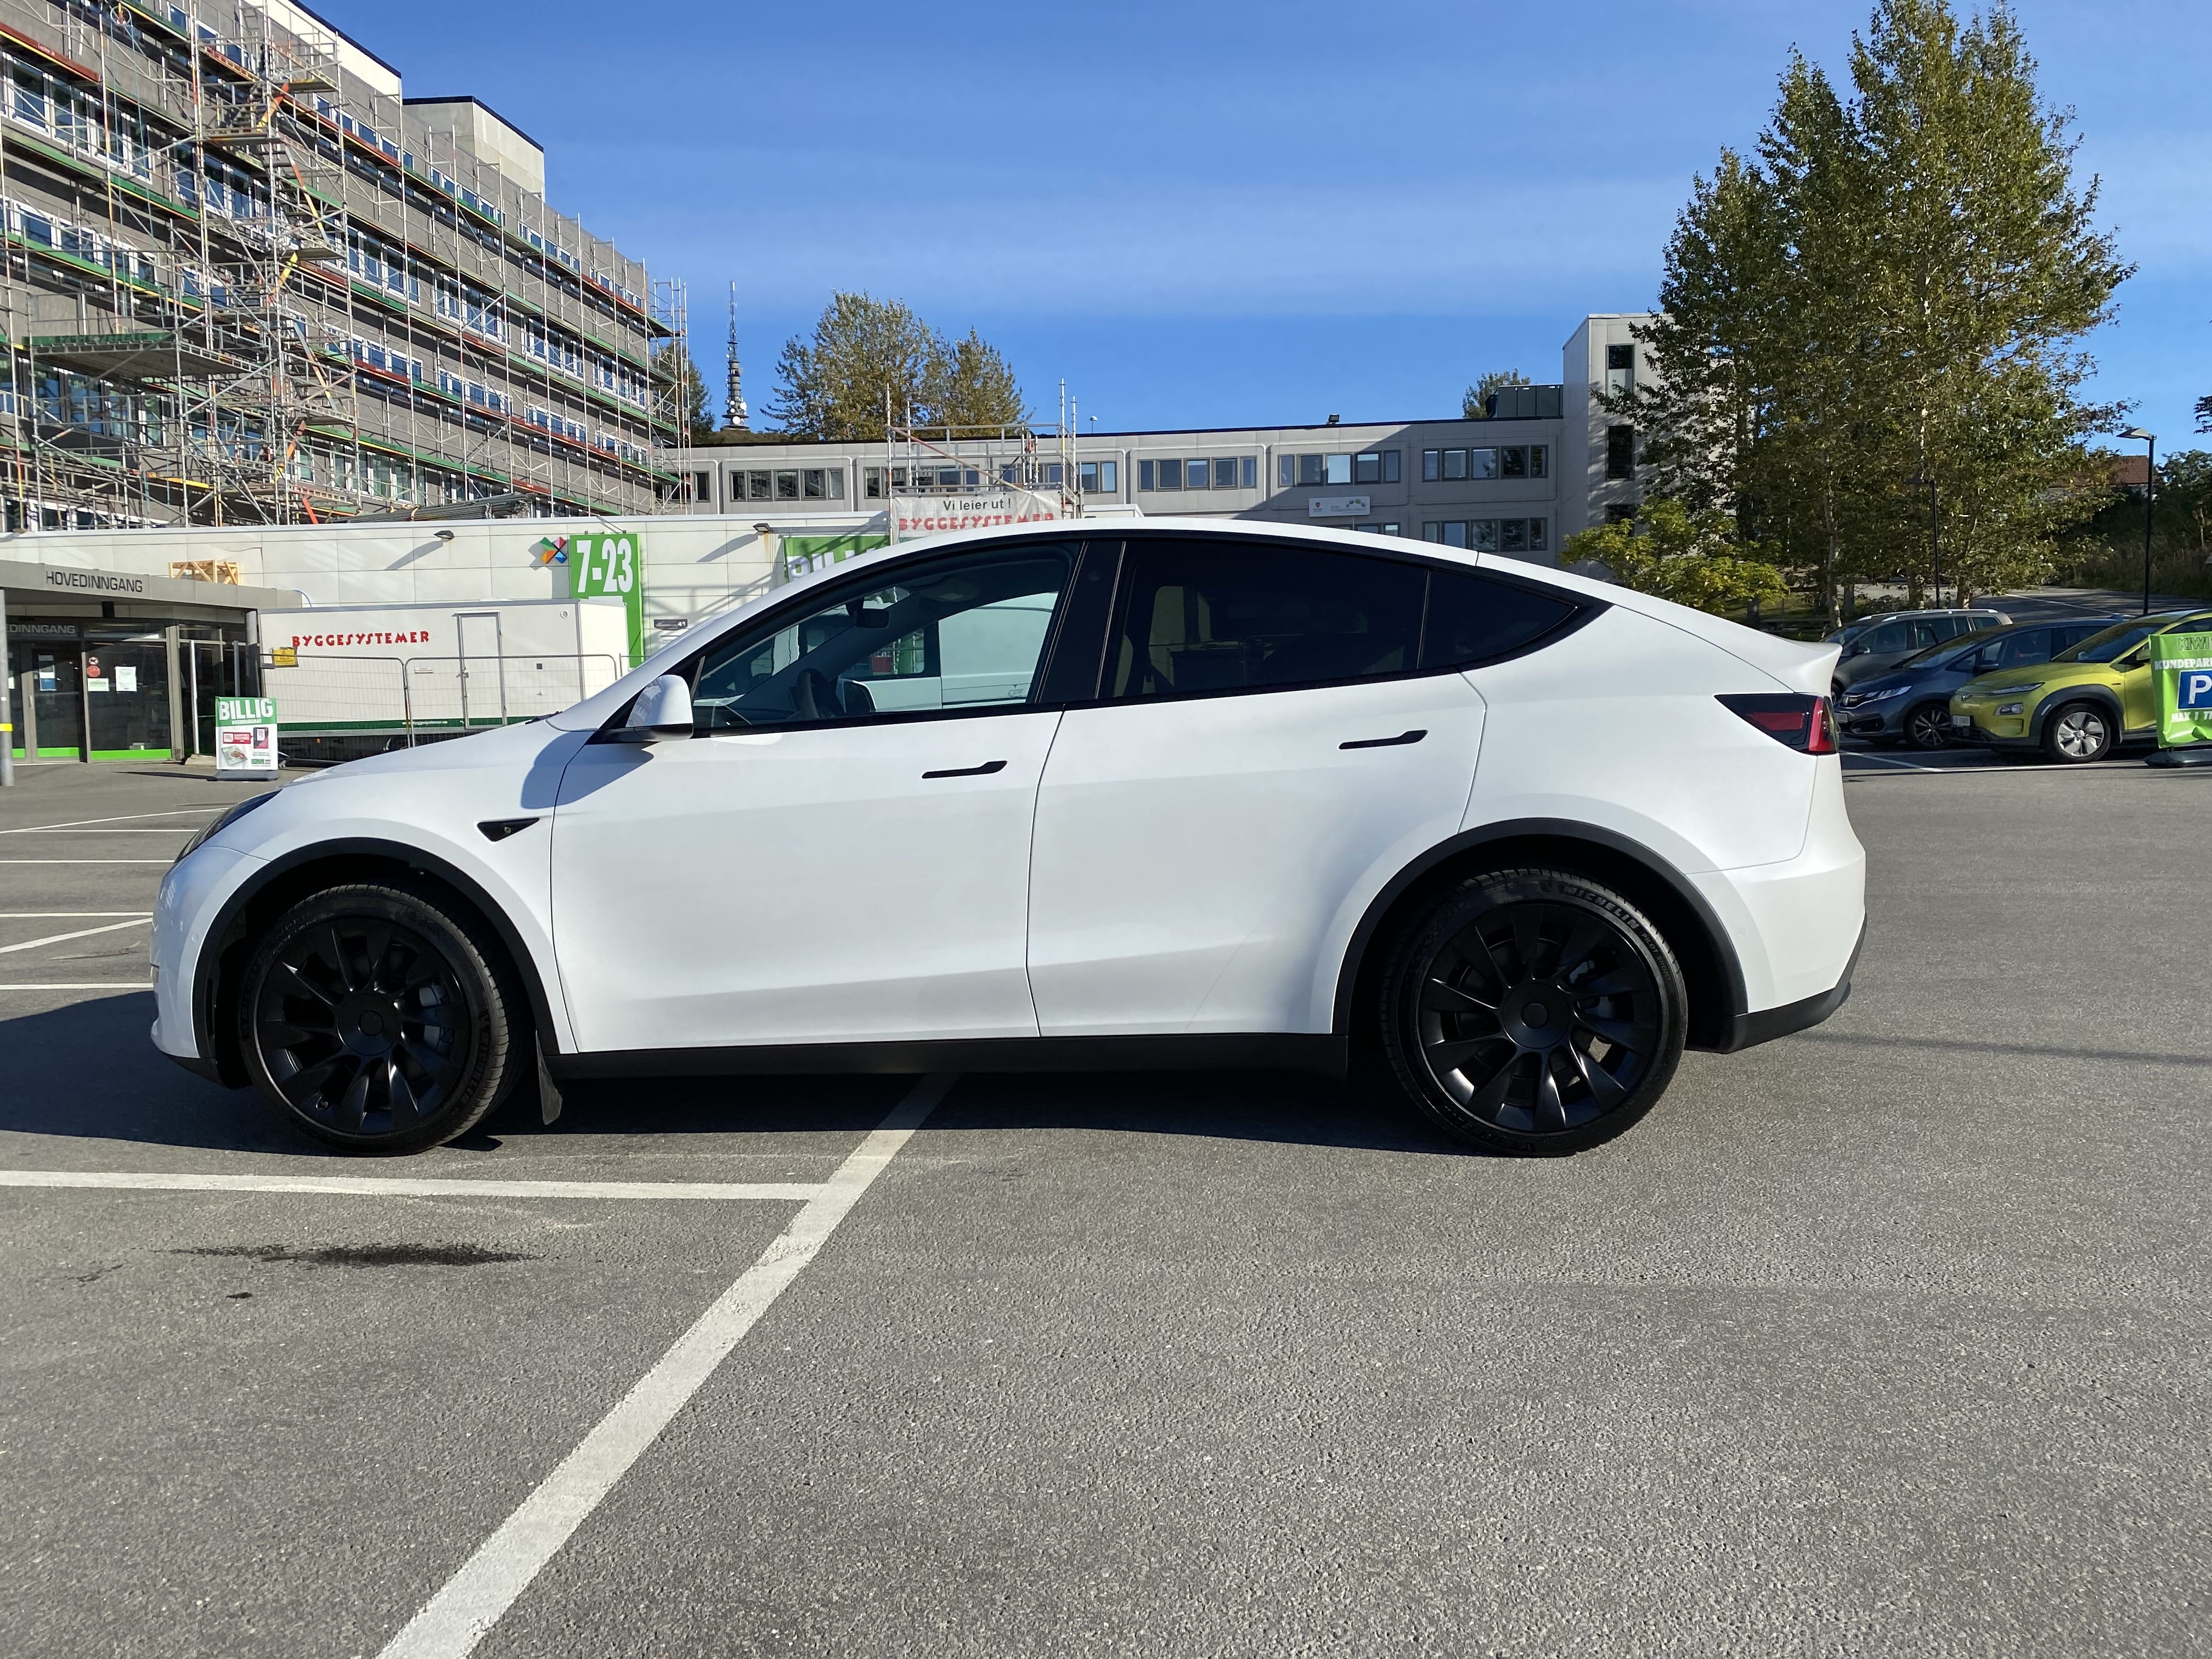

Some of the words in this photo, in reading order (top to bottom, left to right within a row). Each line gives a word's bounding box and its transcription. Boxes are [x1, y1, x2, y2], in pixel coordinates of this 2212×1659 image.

[943, 500, 955, 511] Vi
[960, 500, 988, 510] leier
[991, 499, 1004, 509] ut
[1008, 498, 1011, 508] !
[576, 538, 633, 593] 7-23
[46, 571, 143, 592] HOVEDINNGANG
[292, 631, 429, 647] BYGGESYSTEMER
[2178, 635, 2210, 651] KIWI
[2188, 675, 2212, 704] P
[219, 698, 273, 720] BILLIG
[2171, 712, 2191, 723] MAX
[1564, 885, 1639, 929] MICHELIN
[1641, 934, 1658, 953] PILOT
[1656, 956, 1671, 981] SPORT
